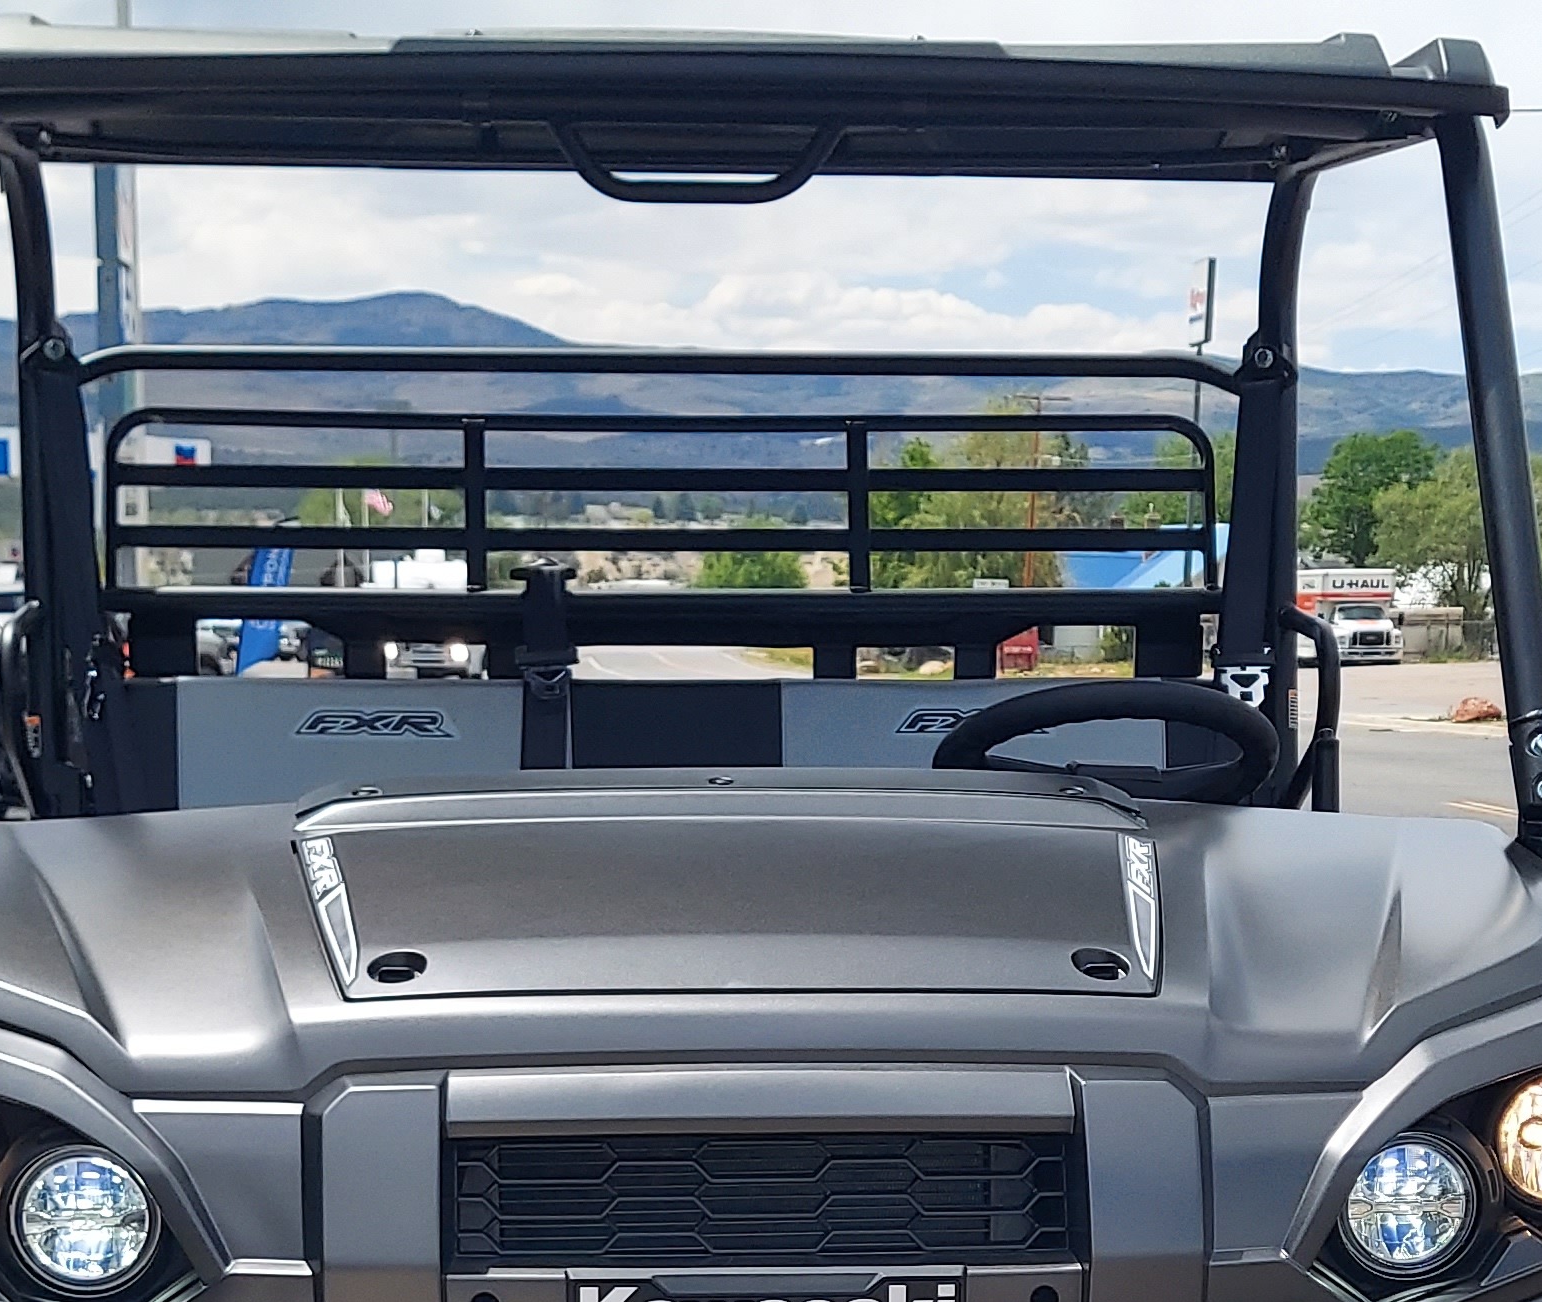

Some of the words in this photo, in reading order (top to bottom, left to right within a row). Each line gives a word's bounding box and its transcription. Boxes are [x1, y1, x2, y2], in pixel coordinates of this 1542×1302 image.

[295, 710, 454, 737] FXR
[302, 837, 345, 900] FXR
[1125, 836, 1153, 898] FXR
